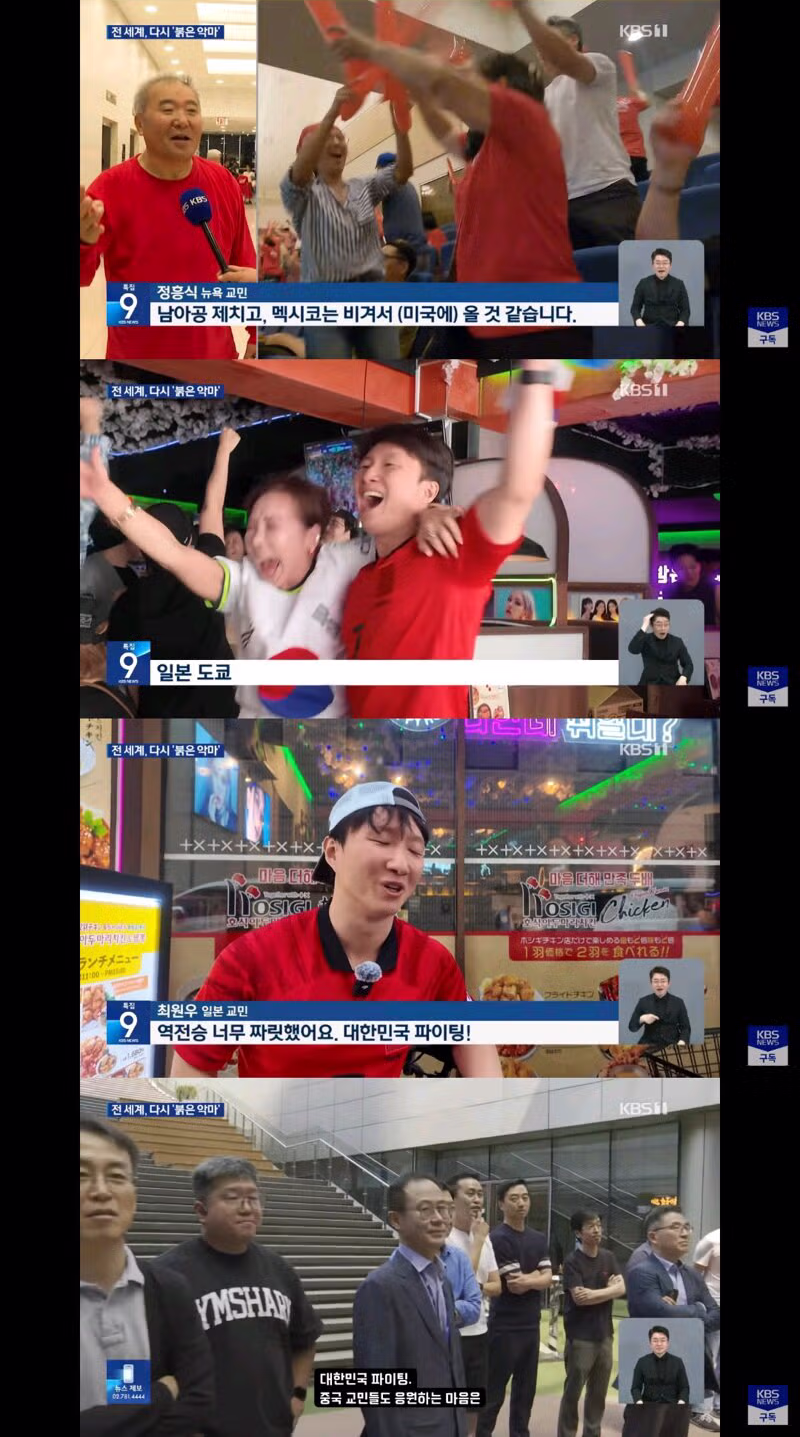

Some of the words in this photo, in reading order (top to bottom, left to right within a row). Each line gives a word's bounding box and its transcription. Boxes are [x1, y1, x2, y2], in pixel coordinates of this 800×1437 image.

[189, 194, 208, 206] KBS
[258, 867, 286, 885] 마음
[550, 871, 574, 886] 마음
[576, 871, 600, 886] 더해
[603, 871, 627, 886] 만족
[629, 871, 654, 887] 두배
[600, 895, 670, 924] Chicken
[523, 917, 598, 929] 호식이두마리치킨
[194, 1286, 292, 1330] YMSHAR
